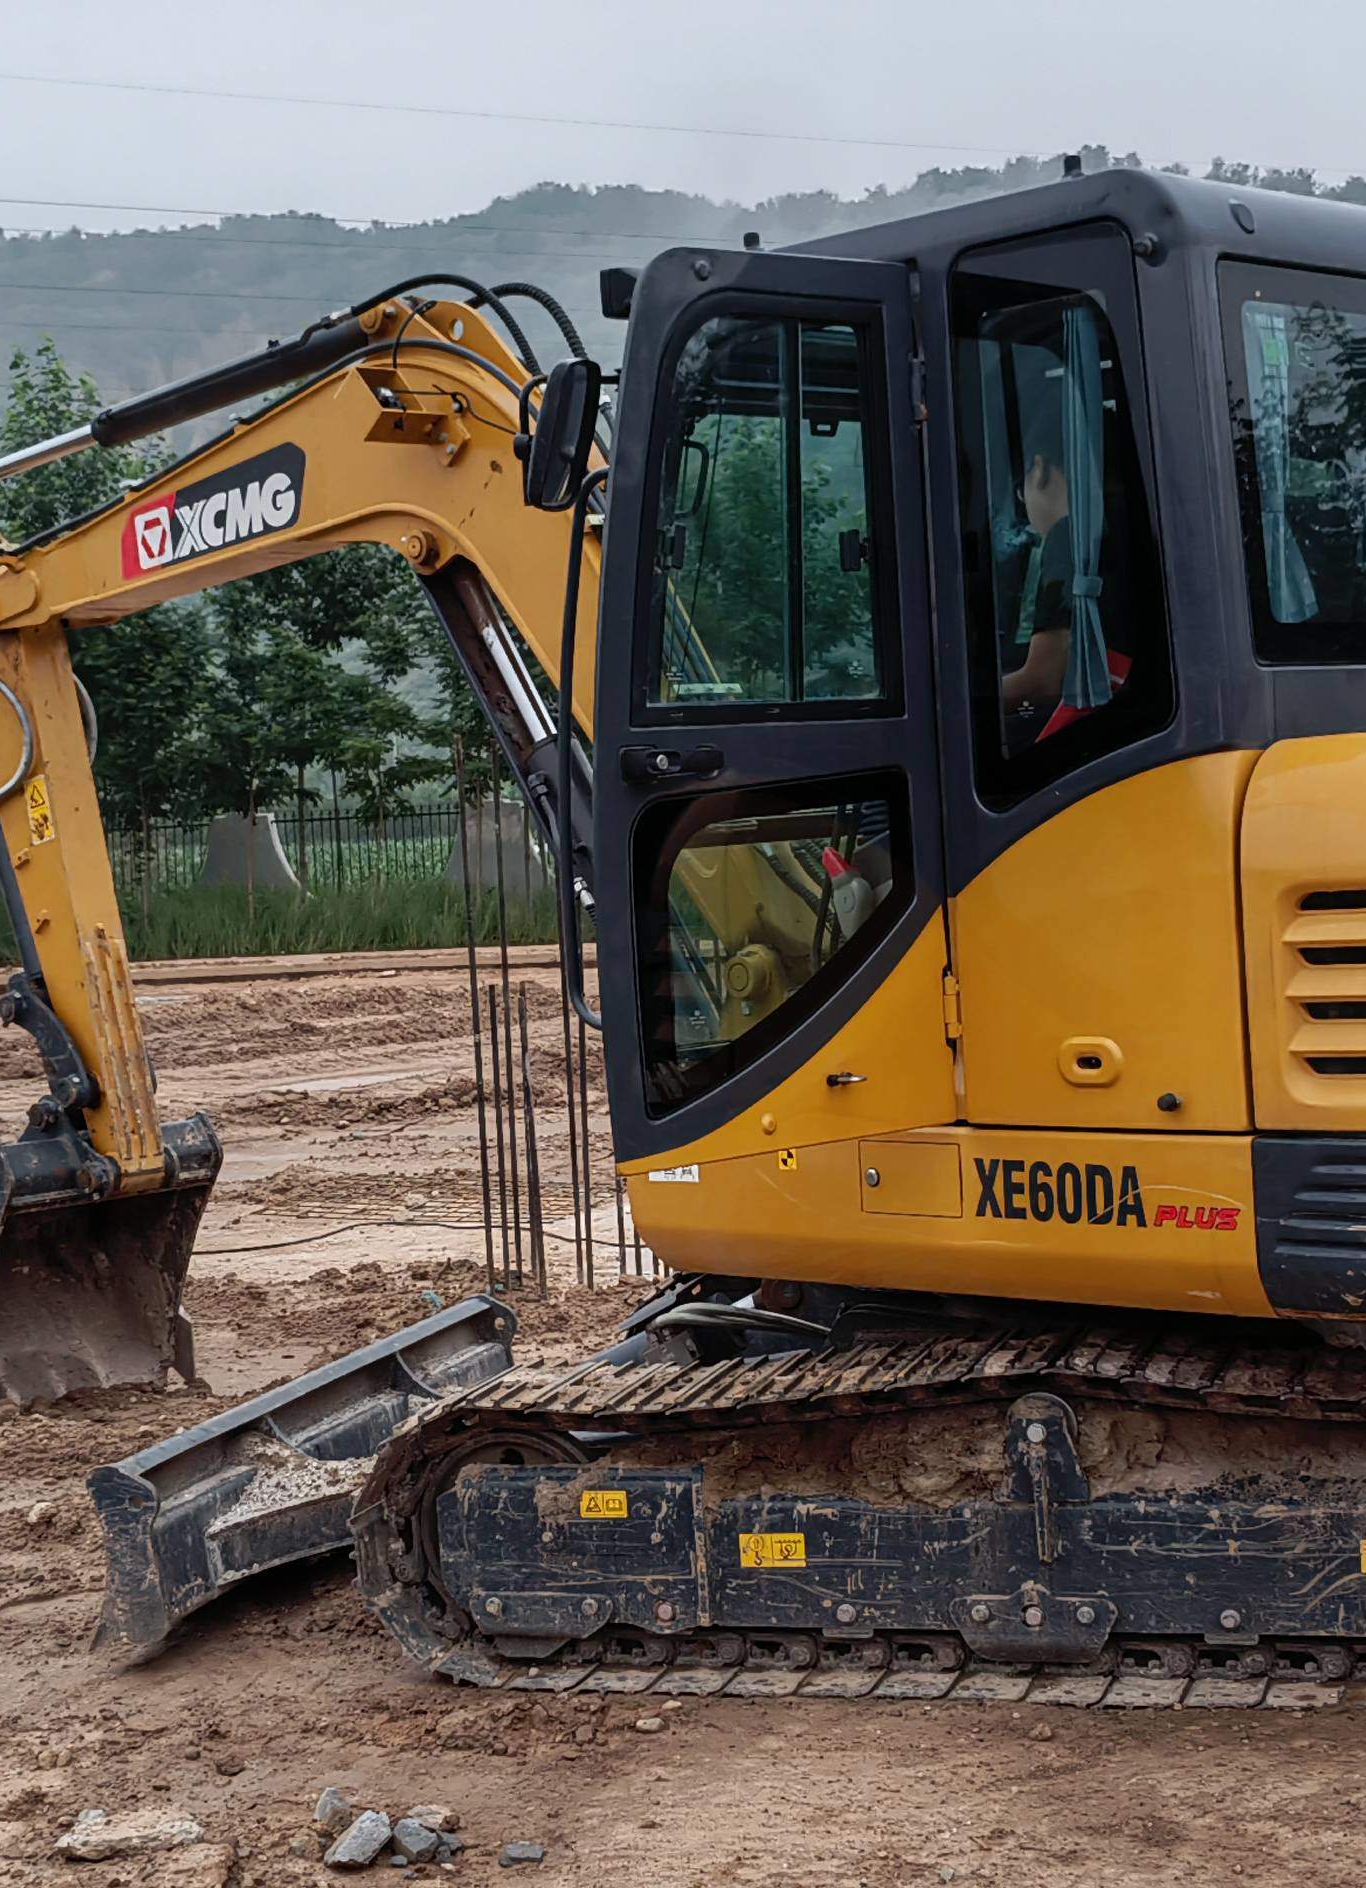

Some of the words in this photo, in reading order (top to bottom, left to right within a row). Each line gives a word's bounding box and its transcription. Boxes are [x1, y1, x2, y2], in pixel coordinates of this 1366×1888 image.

[173, 472, 296, 560] XCMG
[973, 1157, 1148, 1228] XE60DA
[1153, 1204, 1241, 1231] PLUS
